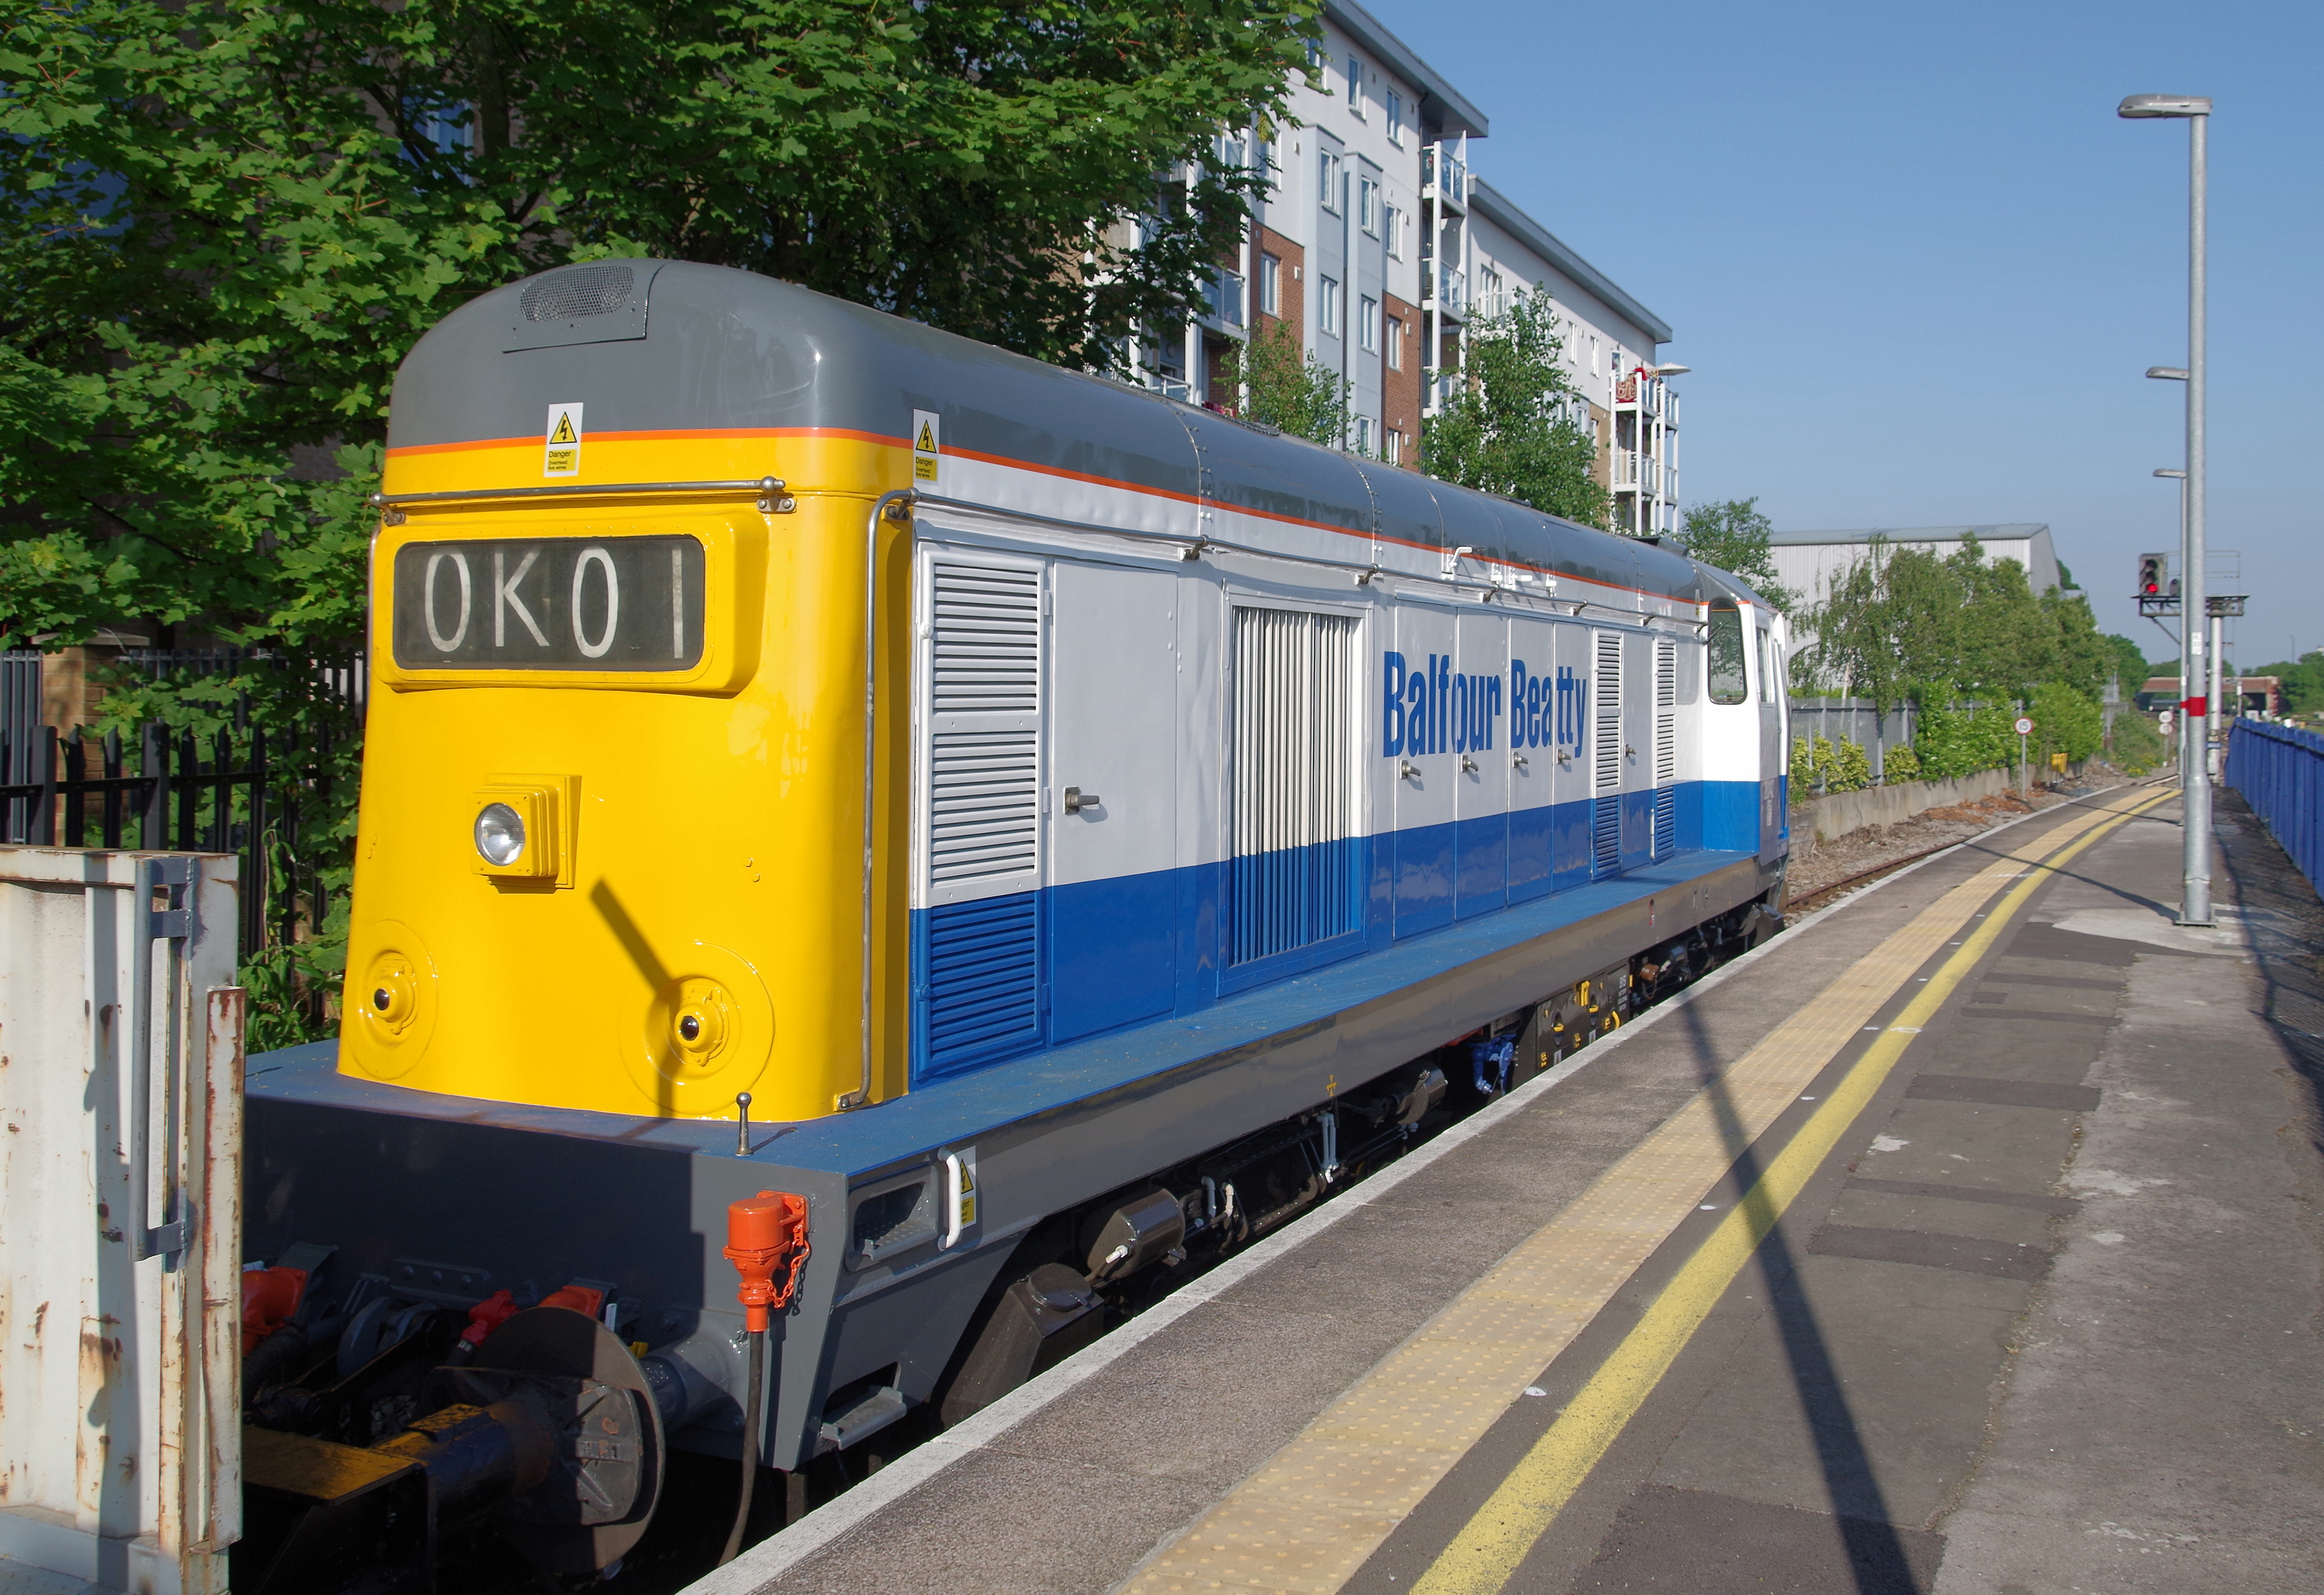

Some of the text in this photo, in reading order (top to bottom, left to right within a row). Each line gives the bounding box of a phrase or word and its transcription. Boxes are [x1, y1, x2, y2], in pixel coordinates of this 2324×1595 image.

[916, 457, 933, 467] Danger
[1383, 651, 1586, 758] Balfour Beatty
[2019, 721, 2028, 730] 15
